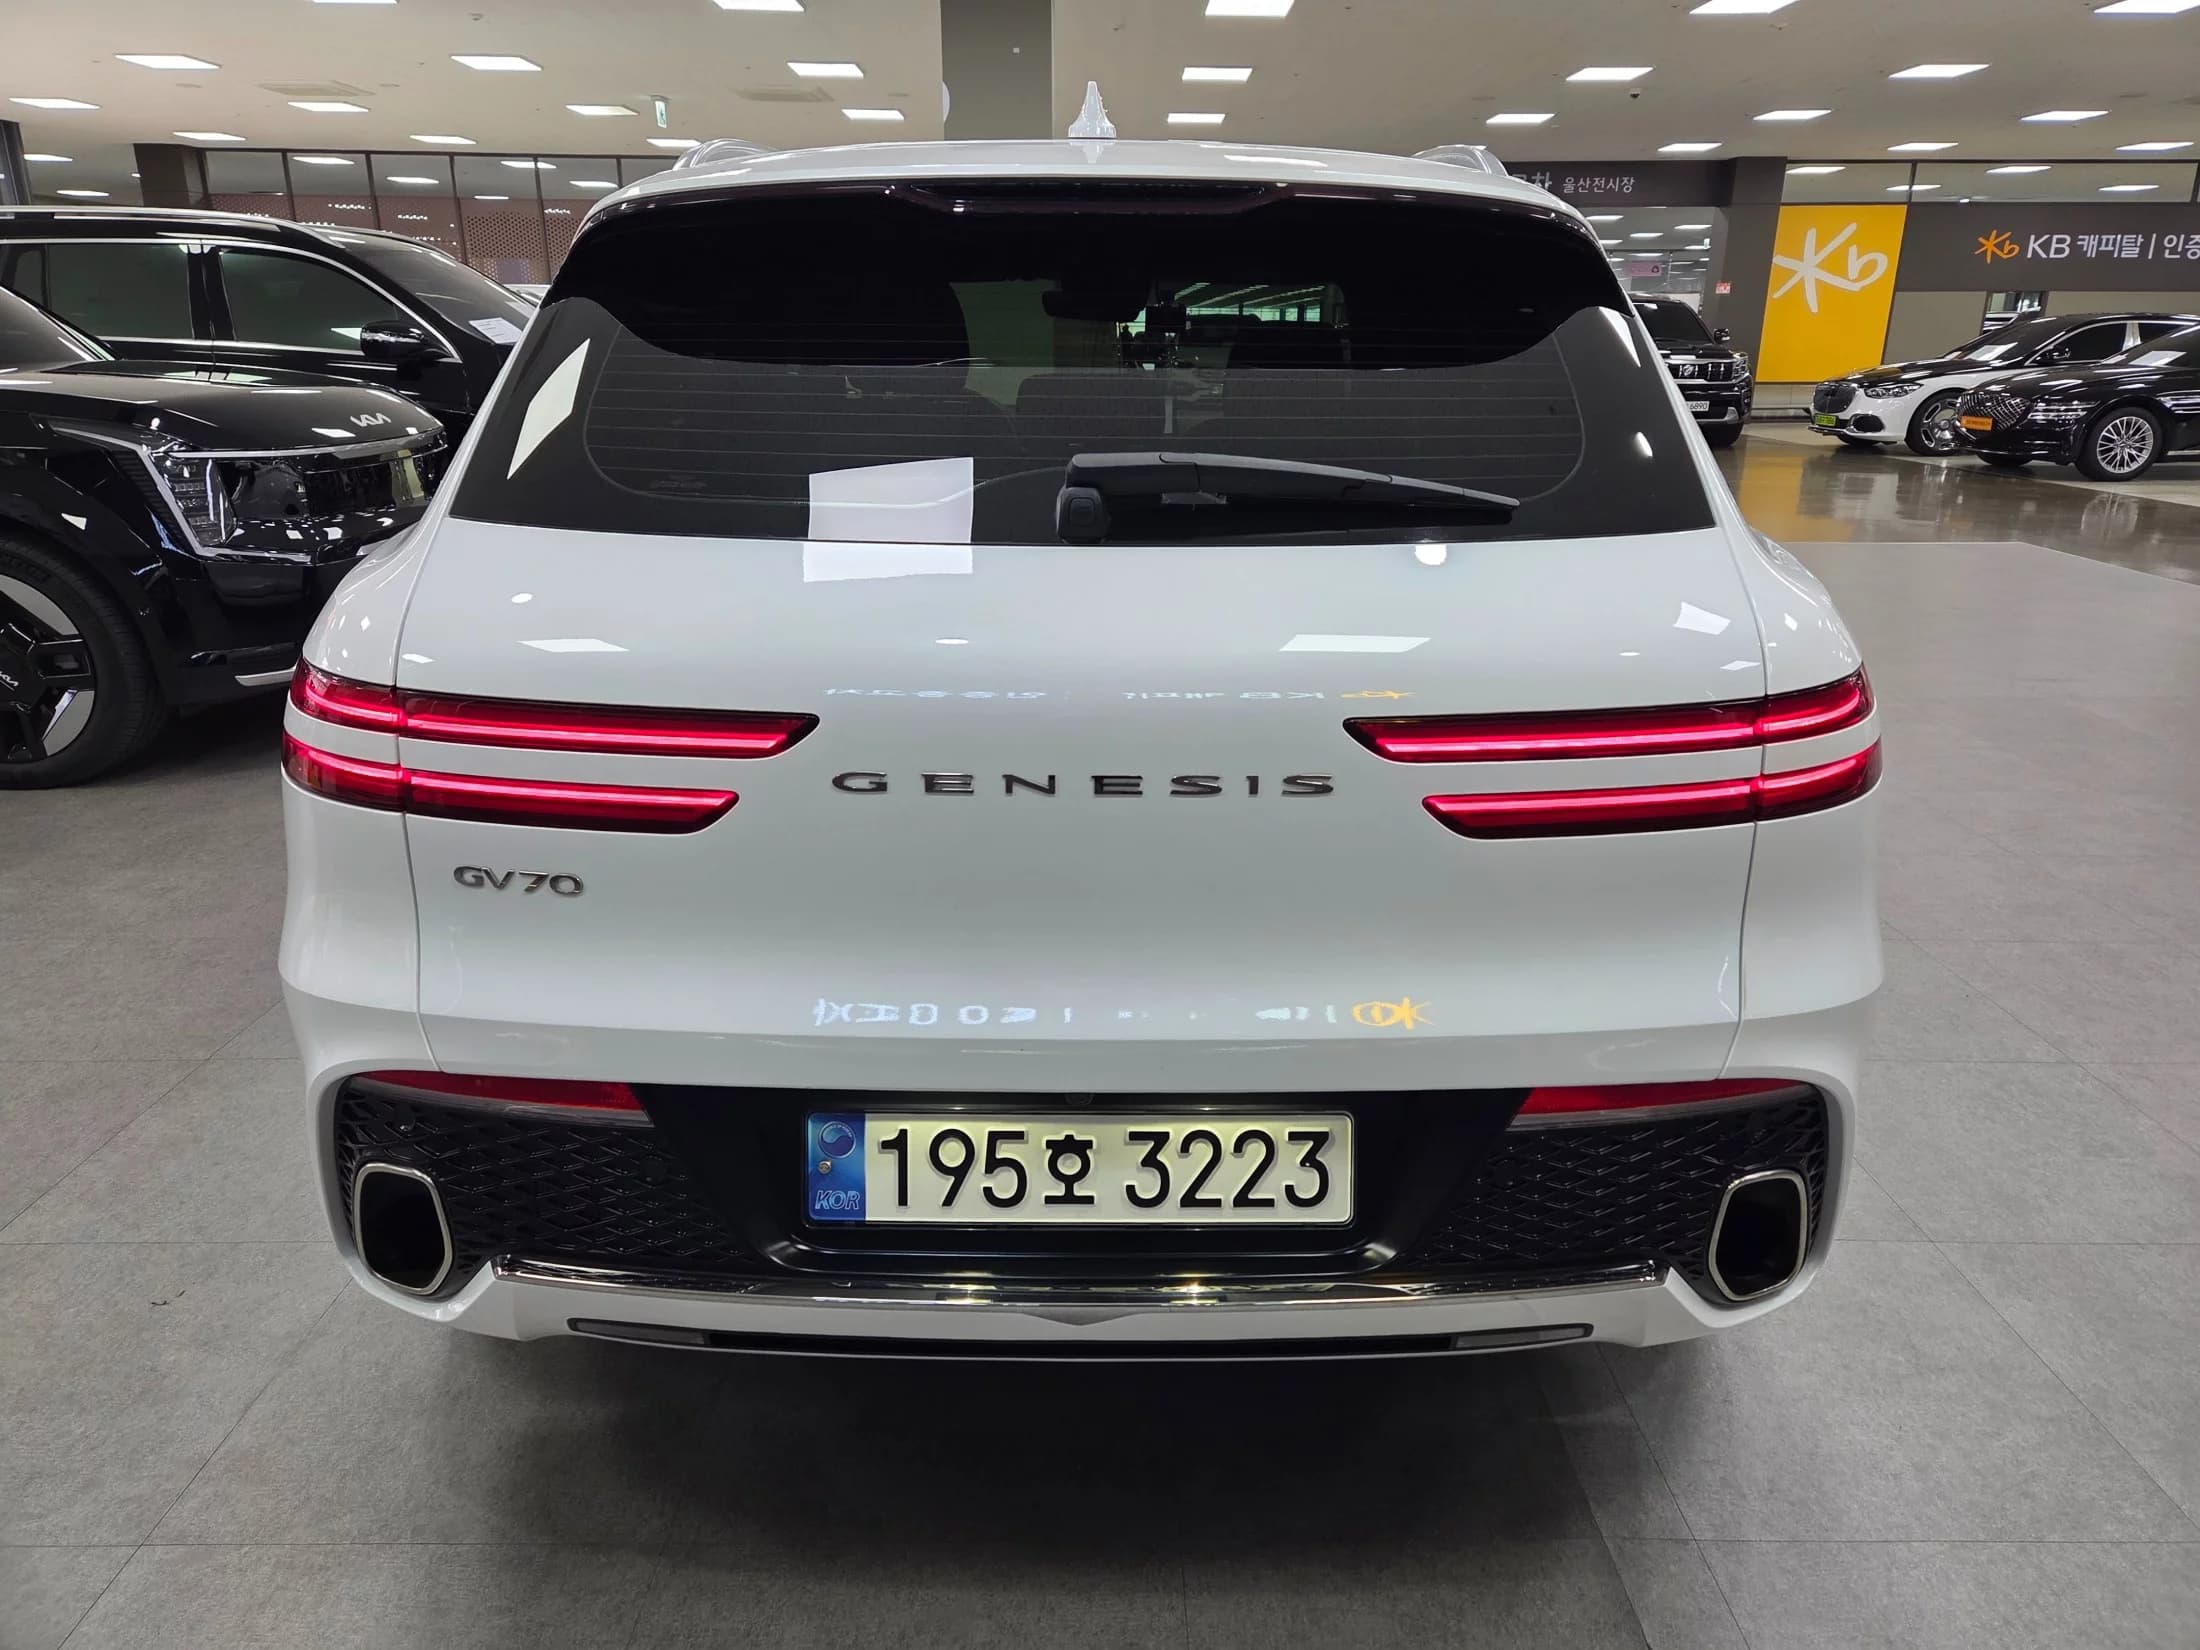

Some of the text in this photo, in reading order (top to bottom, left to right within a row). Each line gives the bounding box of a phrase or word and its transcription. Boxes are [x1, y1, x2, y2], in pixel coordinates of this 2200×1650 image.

[1563, 176, 1635, 194] 울산전시장
[2026, 234, 2072, 259] KB
[2076, 234, 2144, 259] 캐피탈
[831, 771, 1335, 797] GENESIS
[453, 865, 585, 897] GV70
[879, 1127, 1331, 1209] 195호 3223
[815, 1190, 861, 1210] KOR
